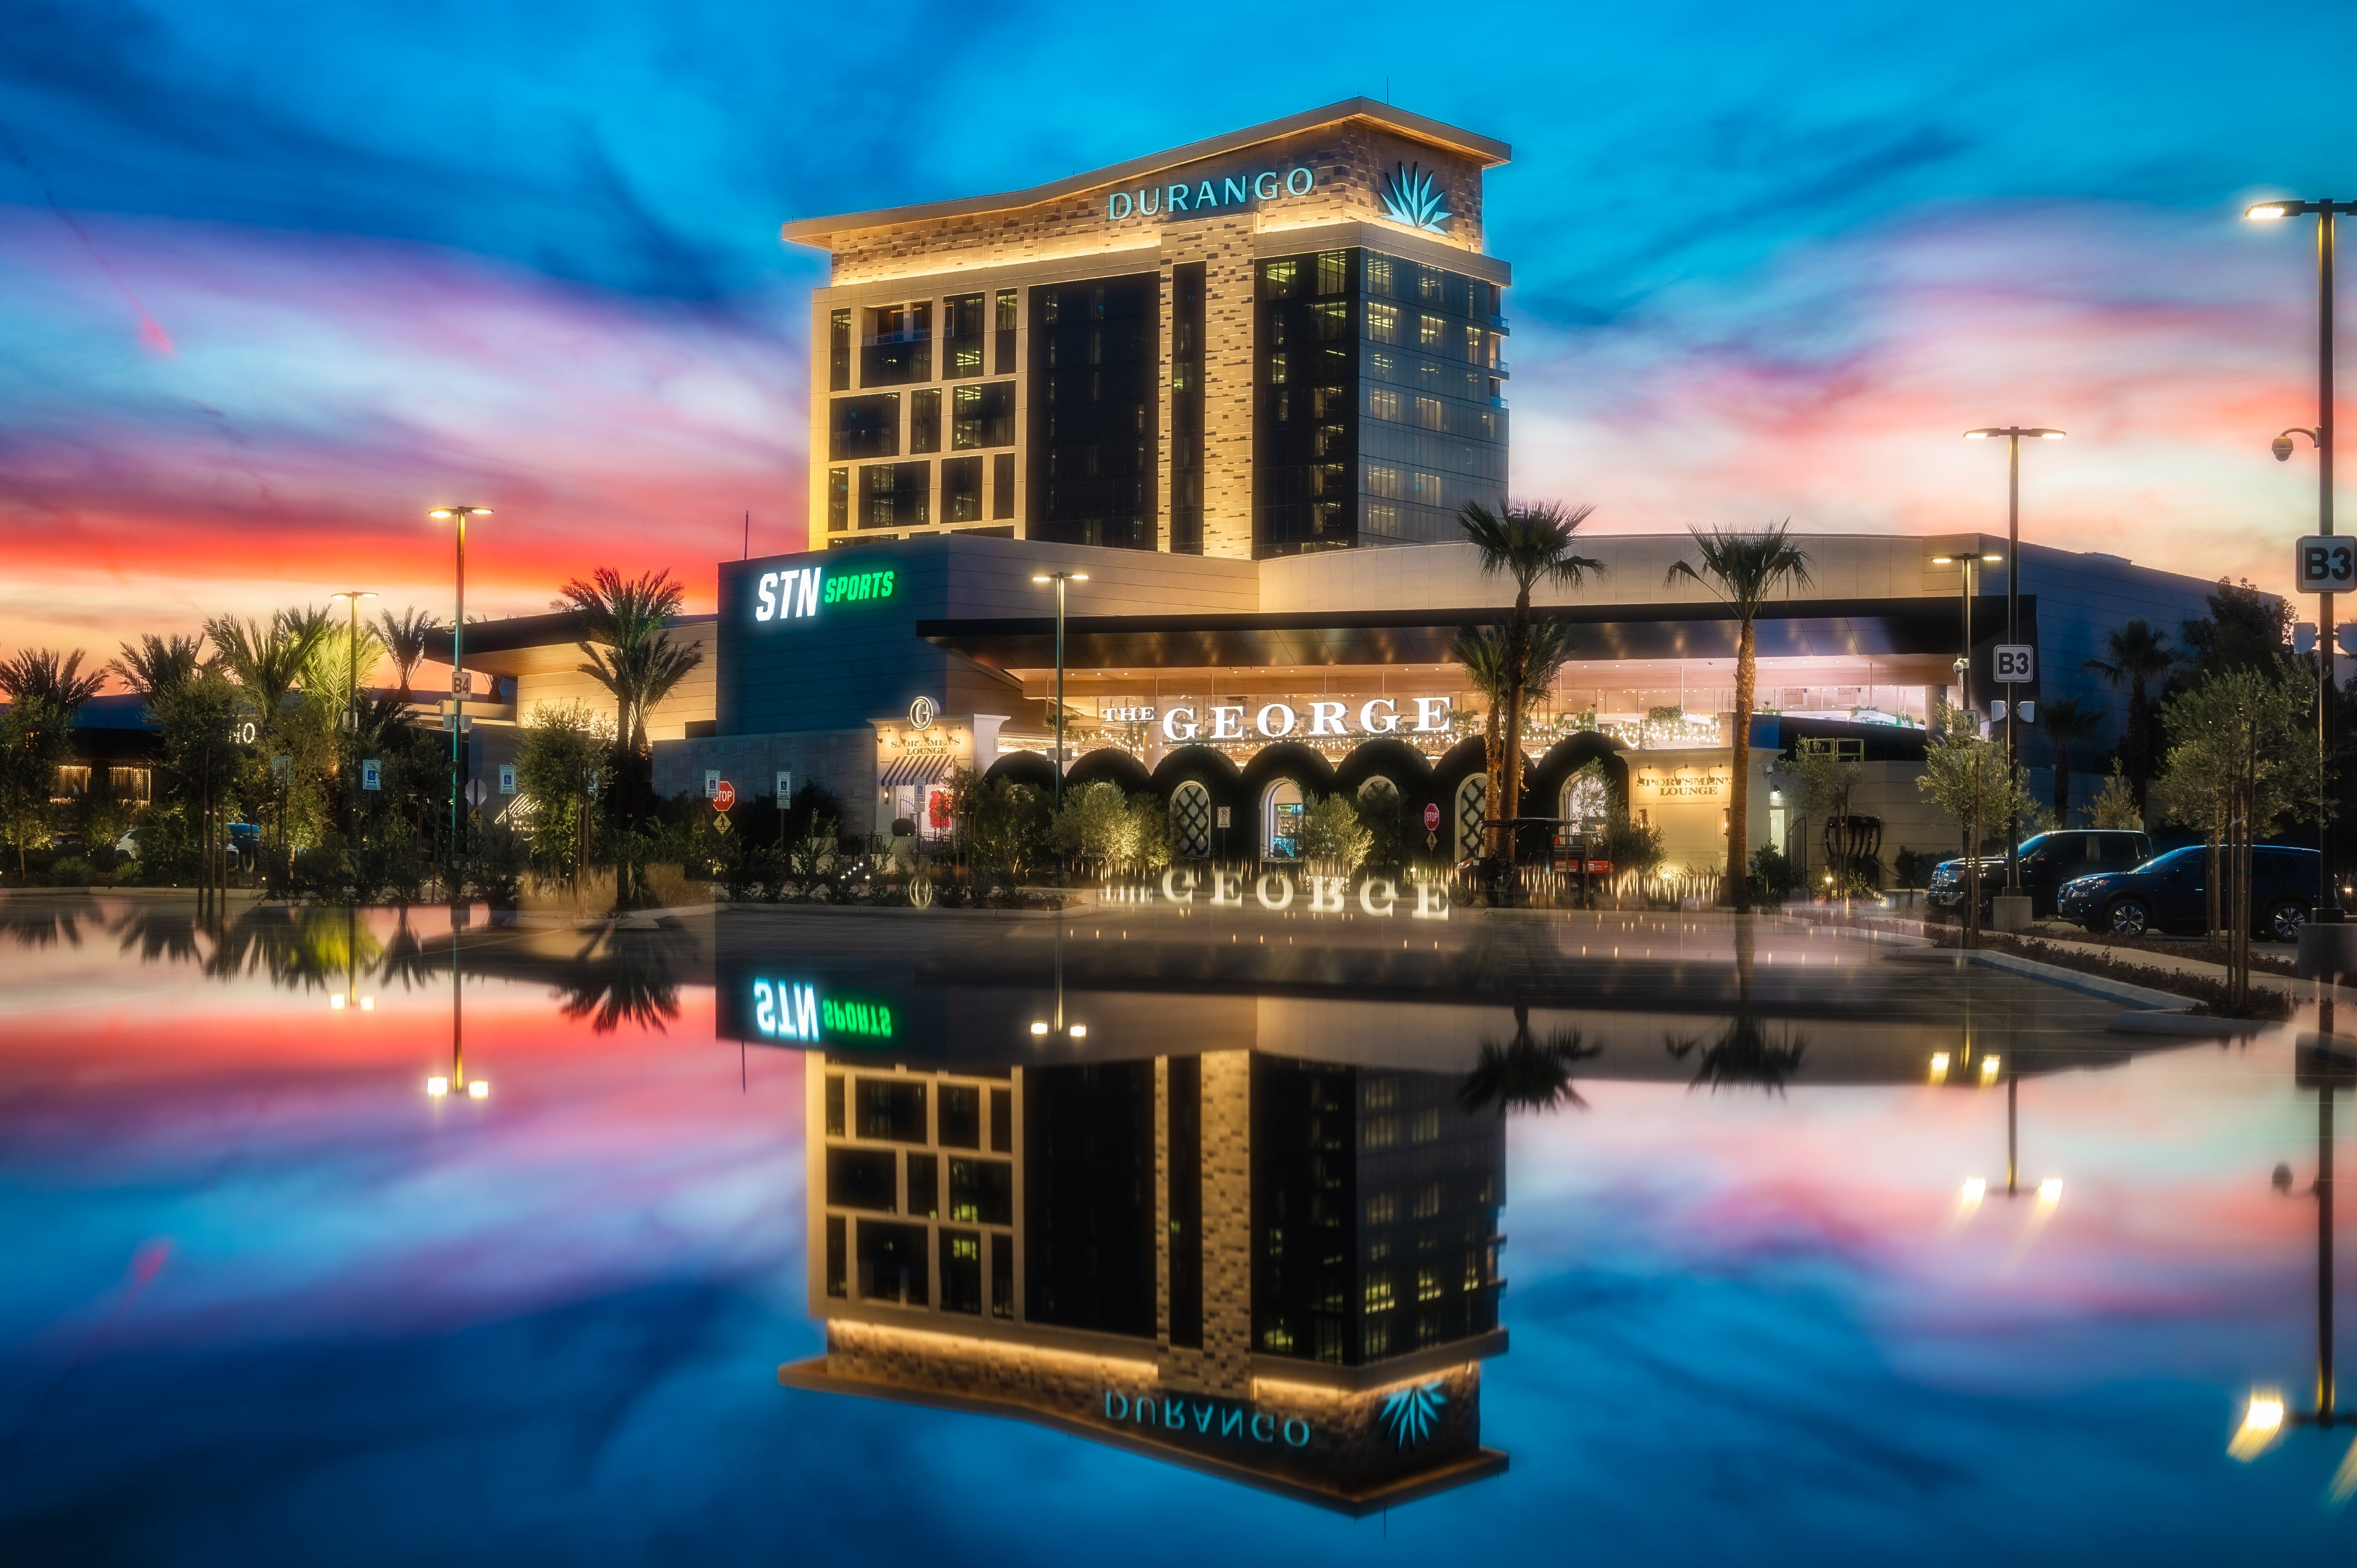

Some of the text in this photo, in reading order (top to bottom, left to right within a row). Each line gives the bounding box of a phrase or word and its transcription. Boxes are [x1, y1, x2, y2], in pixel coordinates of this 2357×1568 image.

[1109, 167, 1313, 220] DURANGO
[2305, 546, 2352, 581] B3
[755, 567, 894, 621] STN SPORTS
[1998, 652, 2029, 675] B3
[454, 677, 469, 694] B4
[1101, 696, 1453, 742] THE GEORGE
[906, 747, 947, 755] LOUNGE
[1660, 787, 1718, 796] LOUNGE
[1426, 812, 1438, 822] STOP
